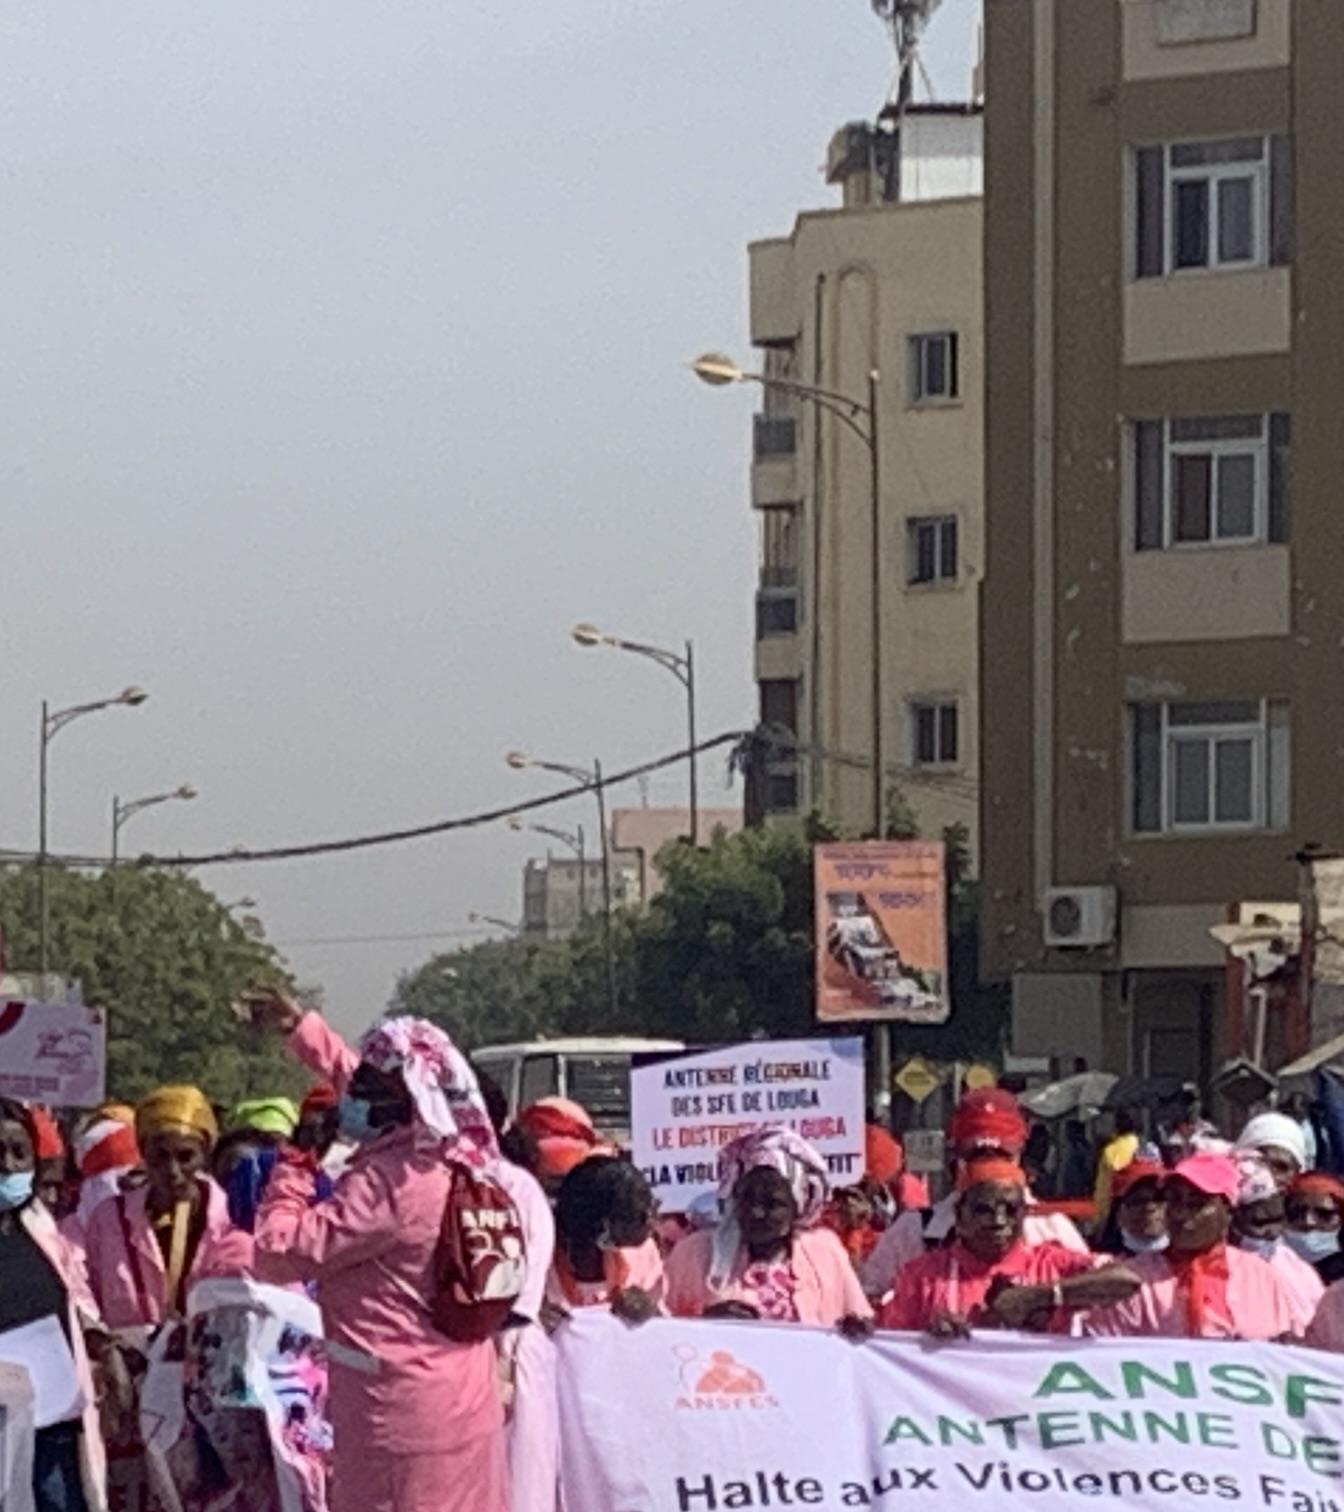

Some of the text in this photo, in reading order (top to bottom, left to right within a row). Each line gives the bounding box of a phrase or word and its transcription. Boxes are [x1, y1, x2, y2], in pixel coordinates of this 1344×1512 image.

[663, 1058, 831, 1089] ANTENNE RÉGIONALE
[671, 1087, 821, 1118] DES SFE DE LOUGA
[652, 1127, 674, 1150] LE
[881, 1410, 1239, 1451] ANTENNE
[1261, 1420, 1344, 1479] DE
[839, 1467, 940, 1507] aux
[954, 1460, 1243, 1502] Violences
